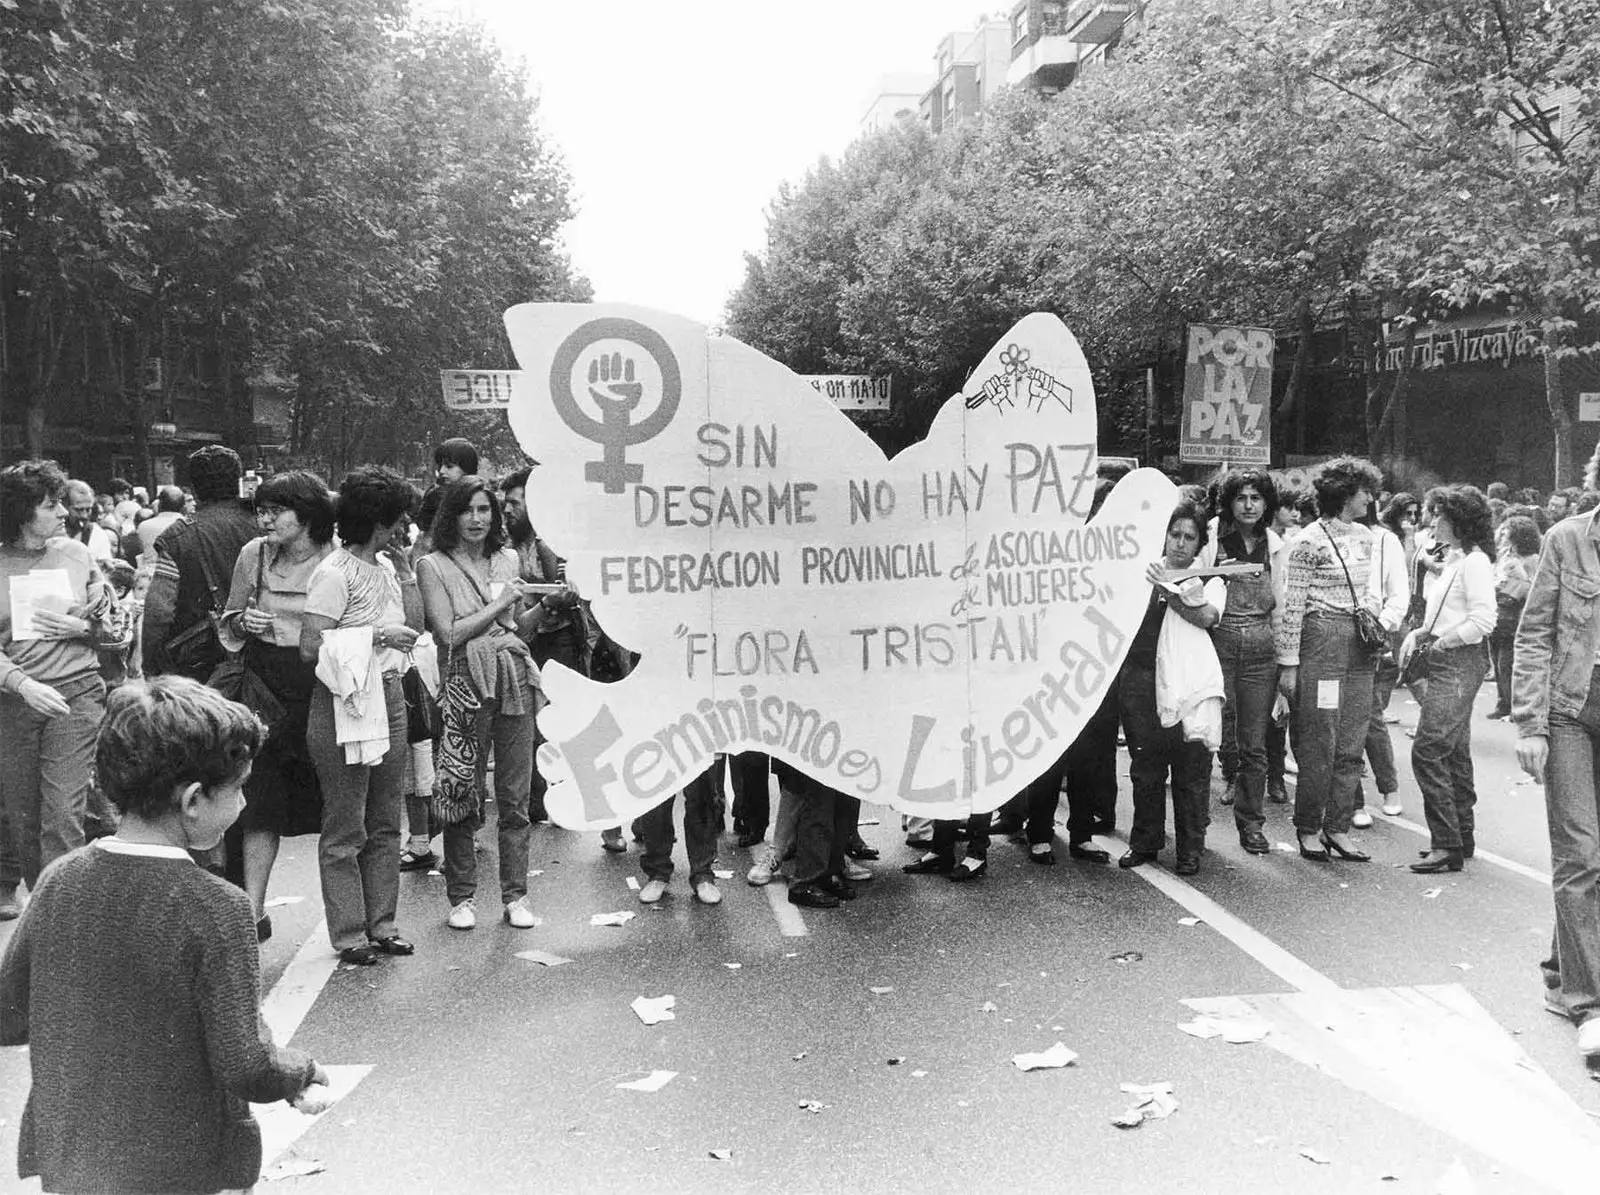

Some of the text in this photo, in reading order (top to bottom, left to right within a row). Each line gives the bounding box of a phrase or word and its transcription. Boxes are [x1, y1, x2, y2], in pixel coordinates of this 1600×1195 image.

[1188, 326, 1271, 368] POR
[1450, 325, 1528, 369] Vizcaya
[1204, 364, 1247, 404] LA
[696, 422, 777, 468] SIN
[1190, 401, 1263, 445] PAZ
[634, 442, 1096, 529] DESARME NO HAY PAZ
[600, 524, 1141, 595] FEDERACION PROVINCIAL de ASOCIACIONES
[951, 583, 982, 617] de
[674, 607, 1048, 680] "FLORA TRISTAN"
[538, 684, 842, 822] "Feminismo
[837, 748, 882, 794] es
